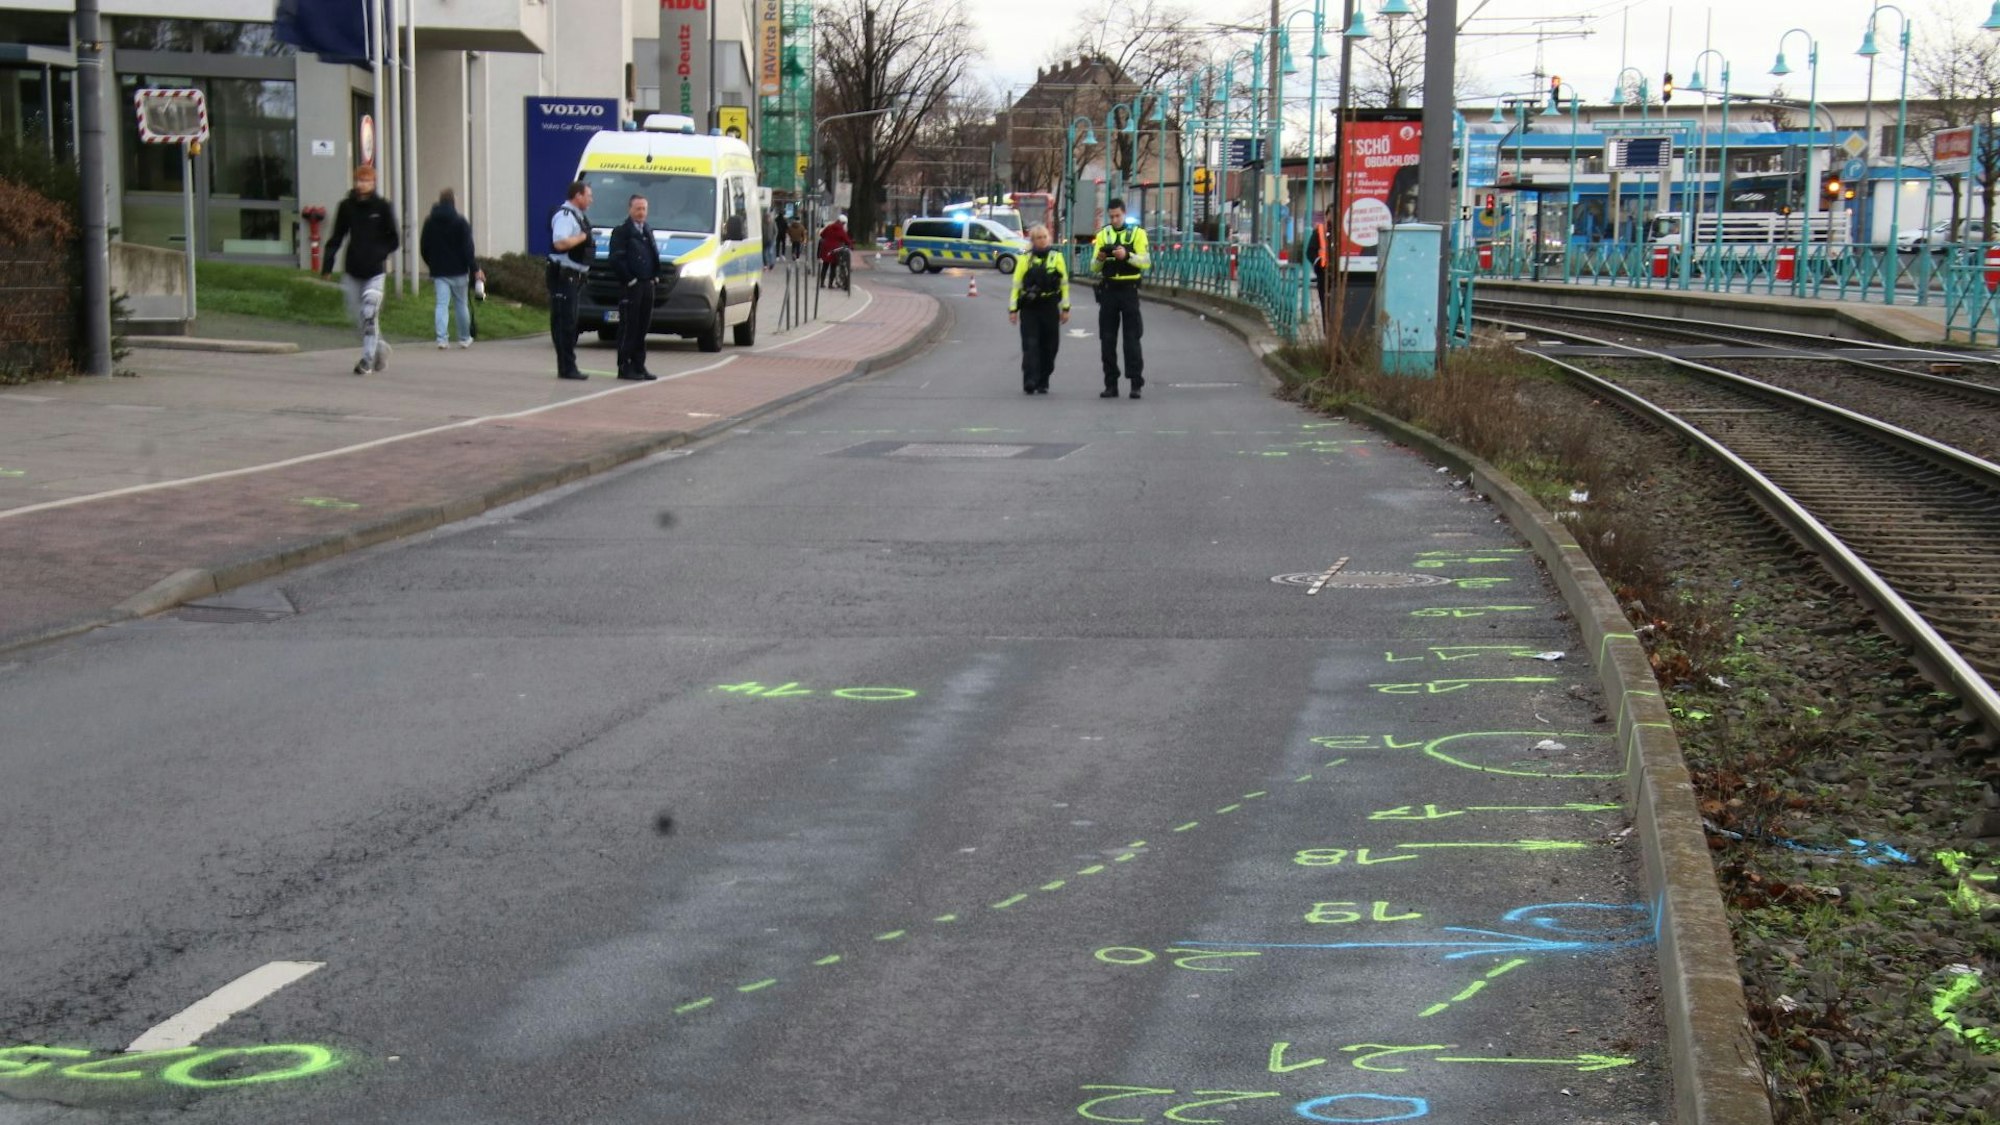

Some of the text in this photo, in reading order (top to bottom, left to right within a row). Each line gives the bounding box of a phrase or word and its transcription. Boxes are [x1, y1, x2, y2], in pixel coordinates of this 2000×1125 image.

[539, 103, 605, 116] VOLVO
[542, 122, 561, 130] Volvo
[574, 123, 604, 131] Germany
[599, 162, 697, 173] UNFALLAUFNAHME
[1294, 848, 1418, 866] 18
[1304, 901, 1422, 923] 19
[1268, 1042, 1446, 1073] 21
[1077, 1085, 1281, 1123] 22
